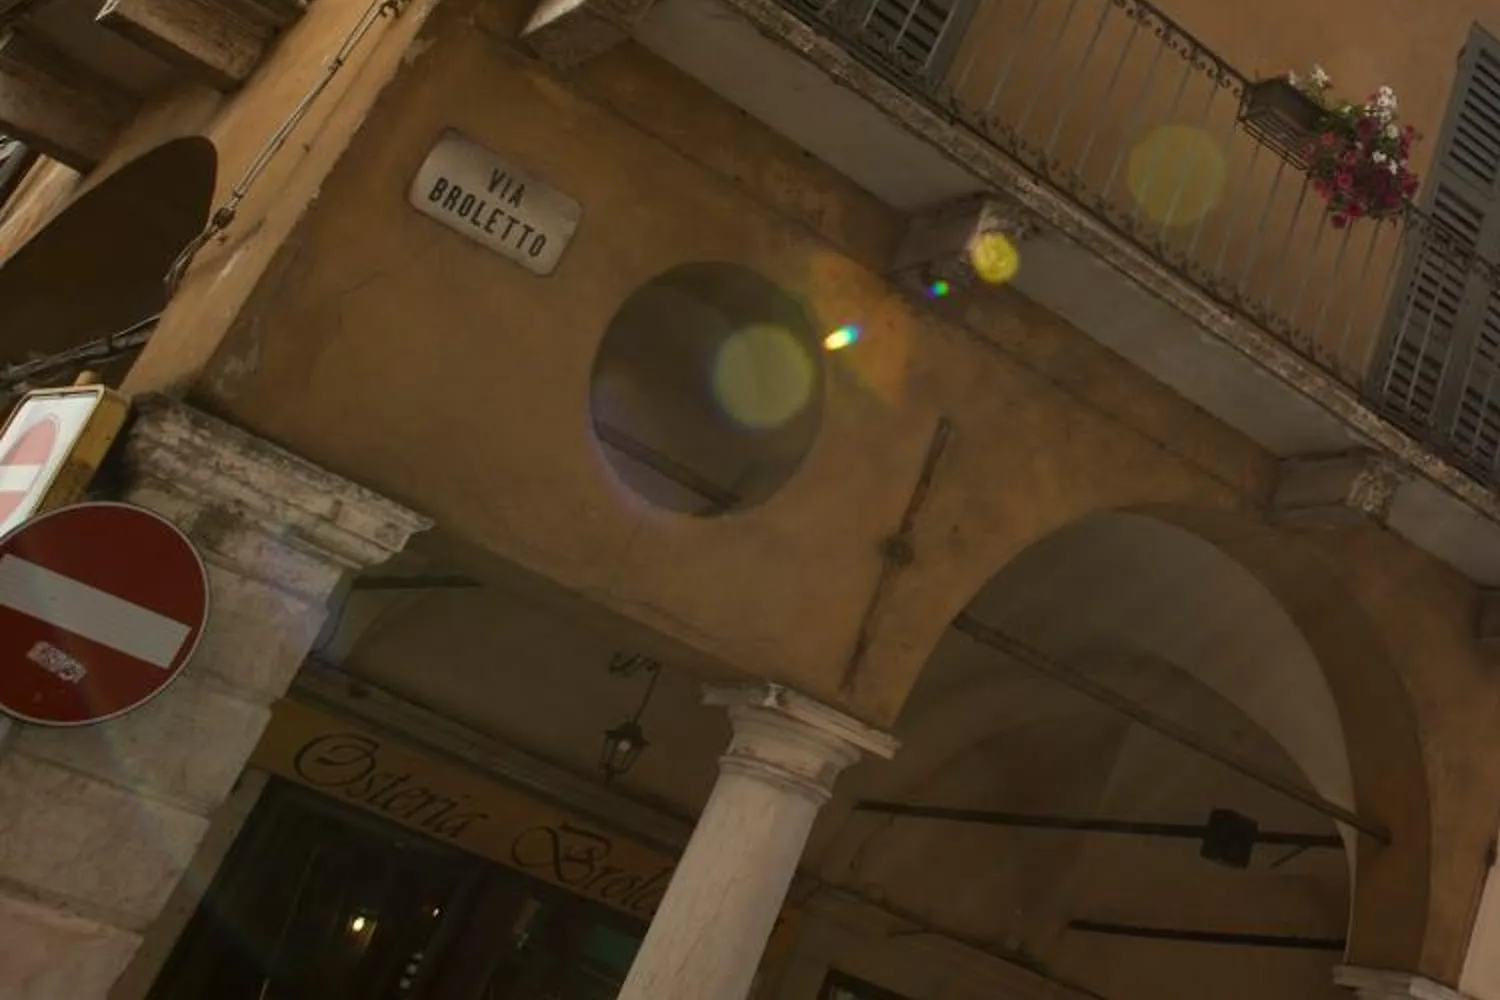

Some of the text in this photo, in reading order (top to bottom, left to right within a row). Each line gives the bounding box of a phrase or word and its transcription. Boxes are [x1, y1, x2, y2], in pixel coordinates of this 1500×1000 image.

[428, 177, 547, 257] BROLETTO
[487, 168, 526, 208] VIA
[294, 733, 488, 838] Osteria
